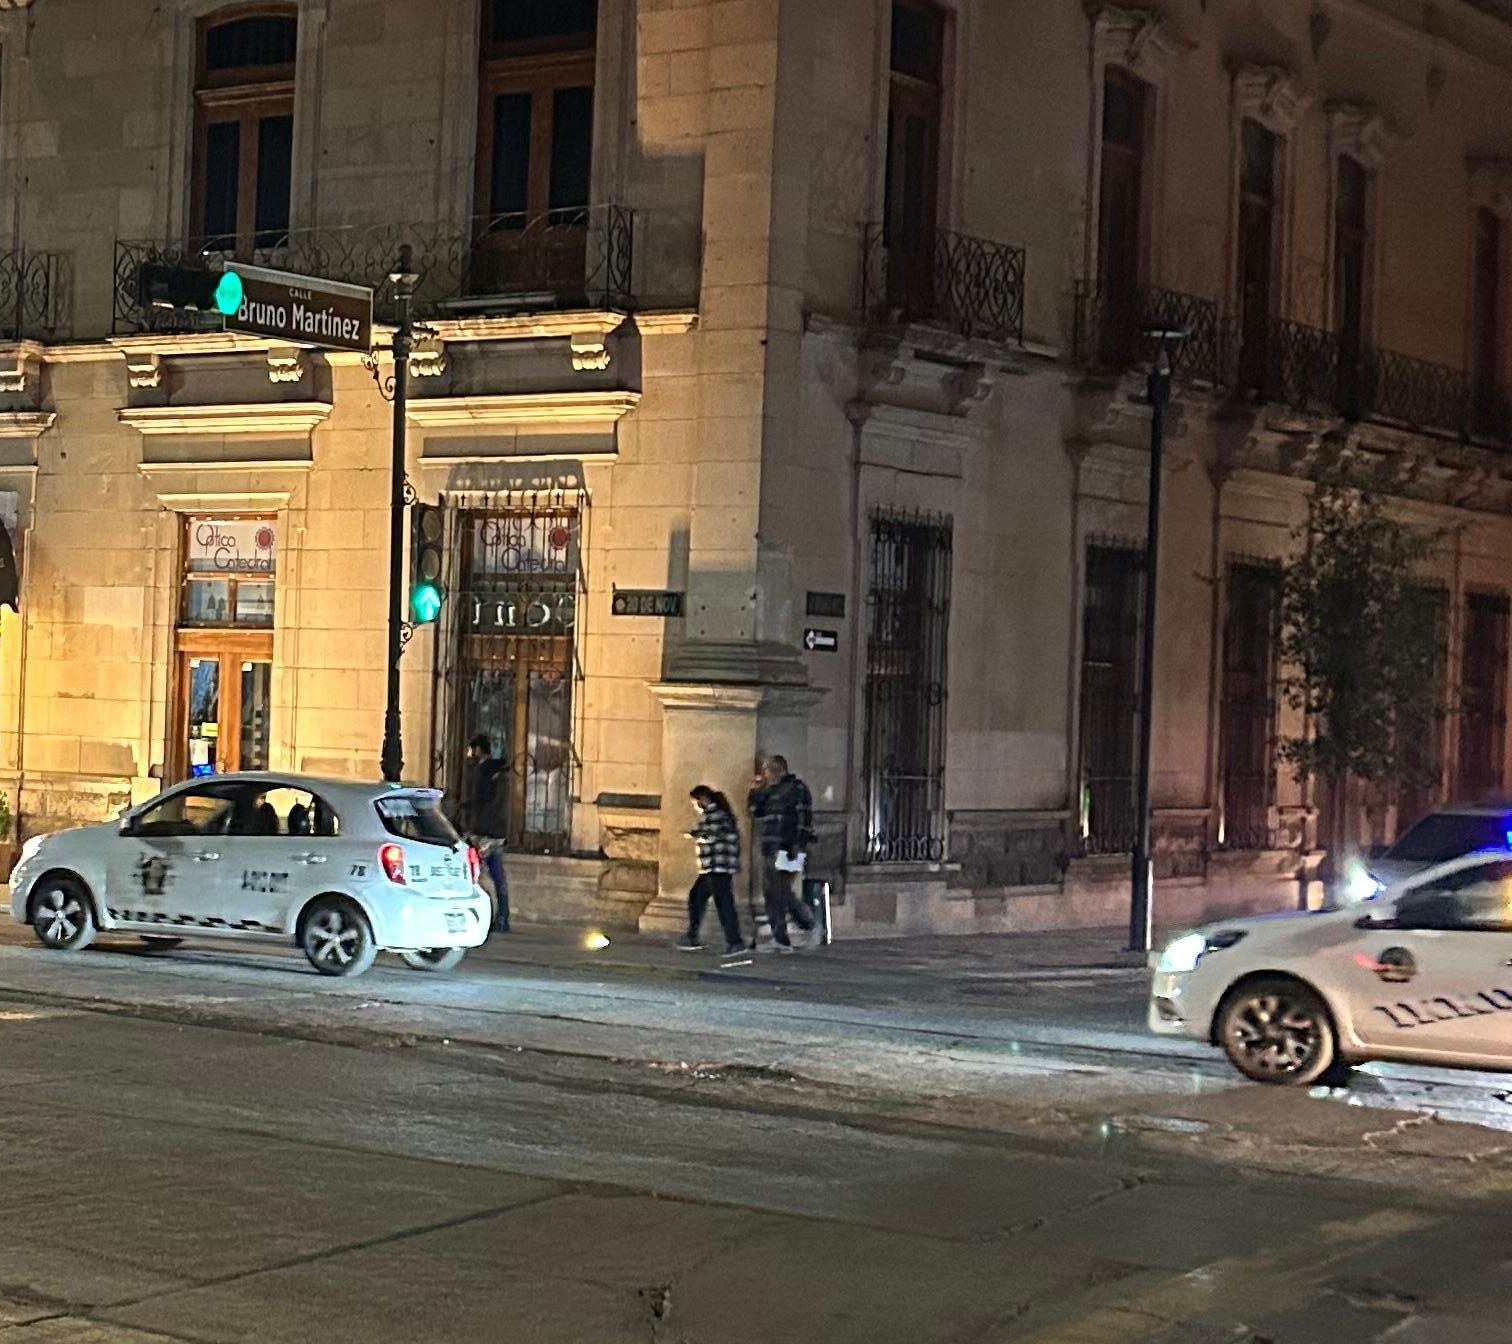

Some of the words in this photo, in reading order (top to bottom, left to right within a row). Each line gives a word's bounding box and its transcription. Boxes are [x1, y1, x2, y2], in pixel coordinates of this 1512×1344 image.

[289, 287, 313, 301] CALLE
[238, 293, 287, 329] Bruno
[292, 302, 361, 341] Martínez
